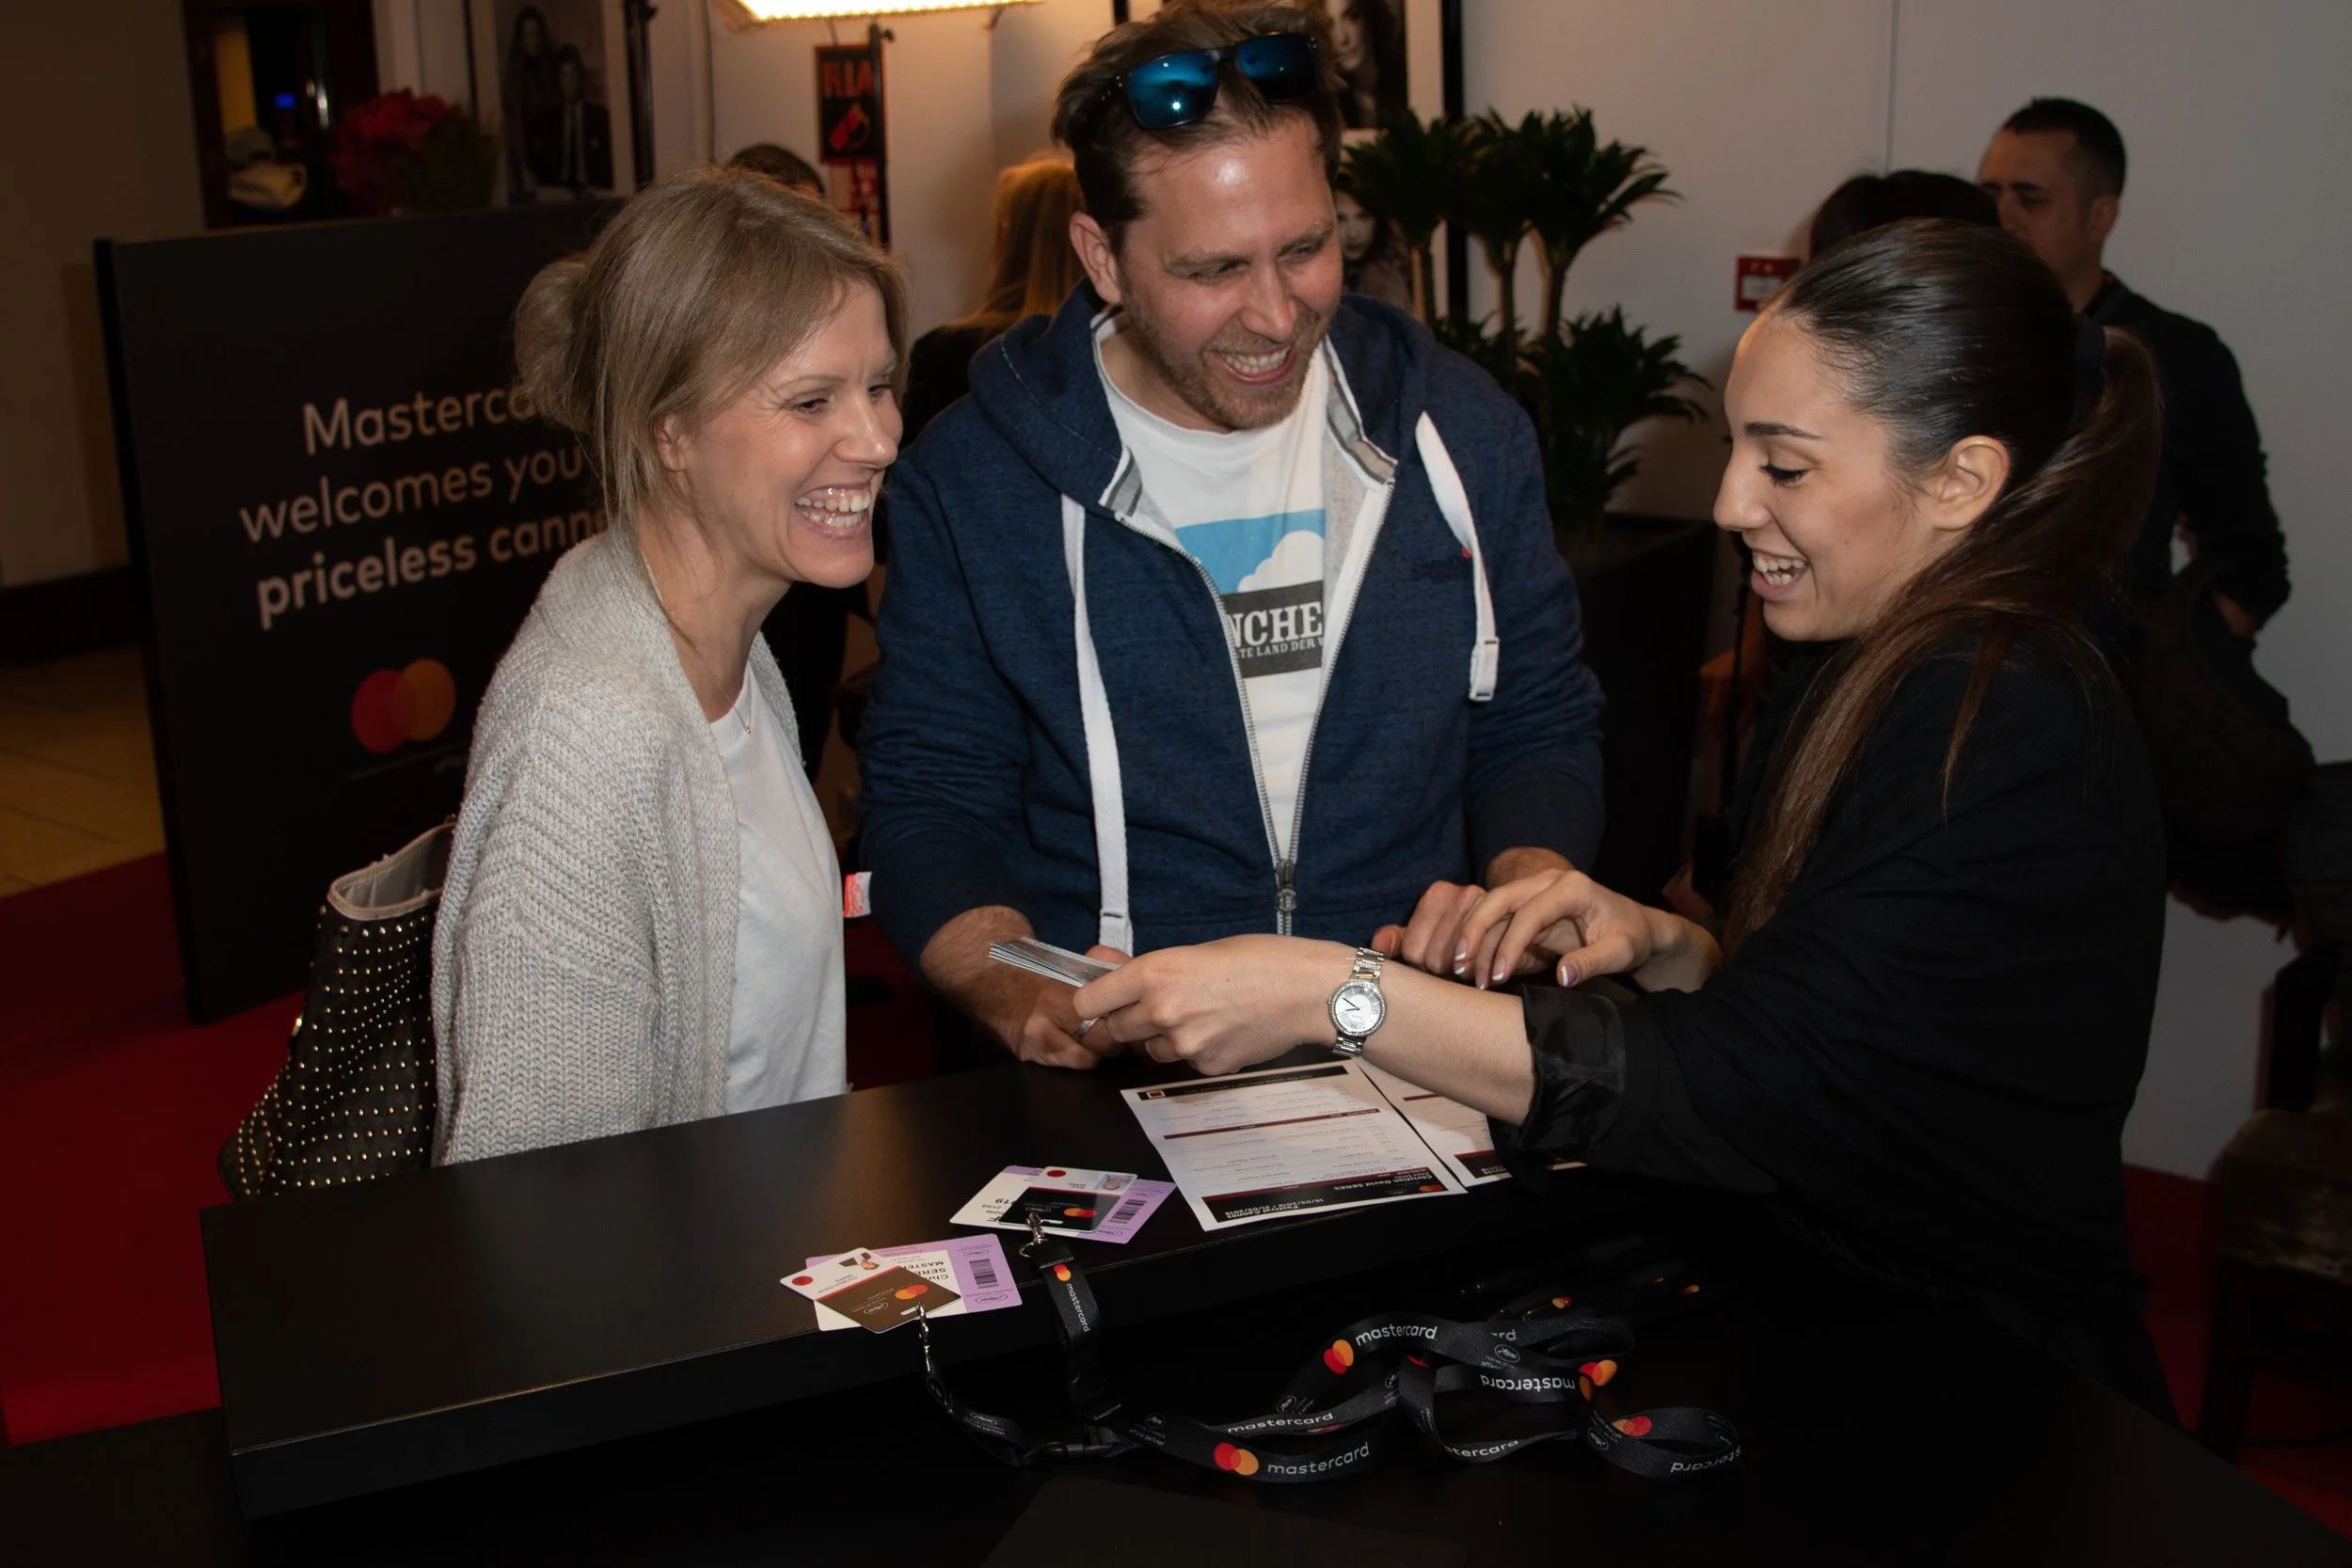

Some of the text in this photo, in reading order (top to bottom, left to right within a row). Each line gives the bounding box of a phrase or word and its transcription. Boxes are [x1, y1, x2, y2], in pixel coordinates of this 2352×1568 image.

[302, 387, 536, 457] Masterca
[239, 446, 585, 544] welcomes you
[257, 533, 476, 631] priceless
[1227, 601, 1323, 648] NCHE
[1256, 642, 1289, 657] LAND
[1291, 638, 1316, 652] DER
[1064, 1281, 1091, 1334] mastercard
[1355, 1323, 1438, 1347] mastercard
[1481, 1374, 1576, 1392] mastercard
[1227, 1412, 1334, 1434] mastercard
[1267, 1441, 1371, 1477] mastercard
[1670, 1445, 1741, 1473] stercard
